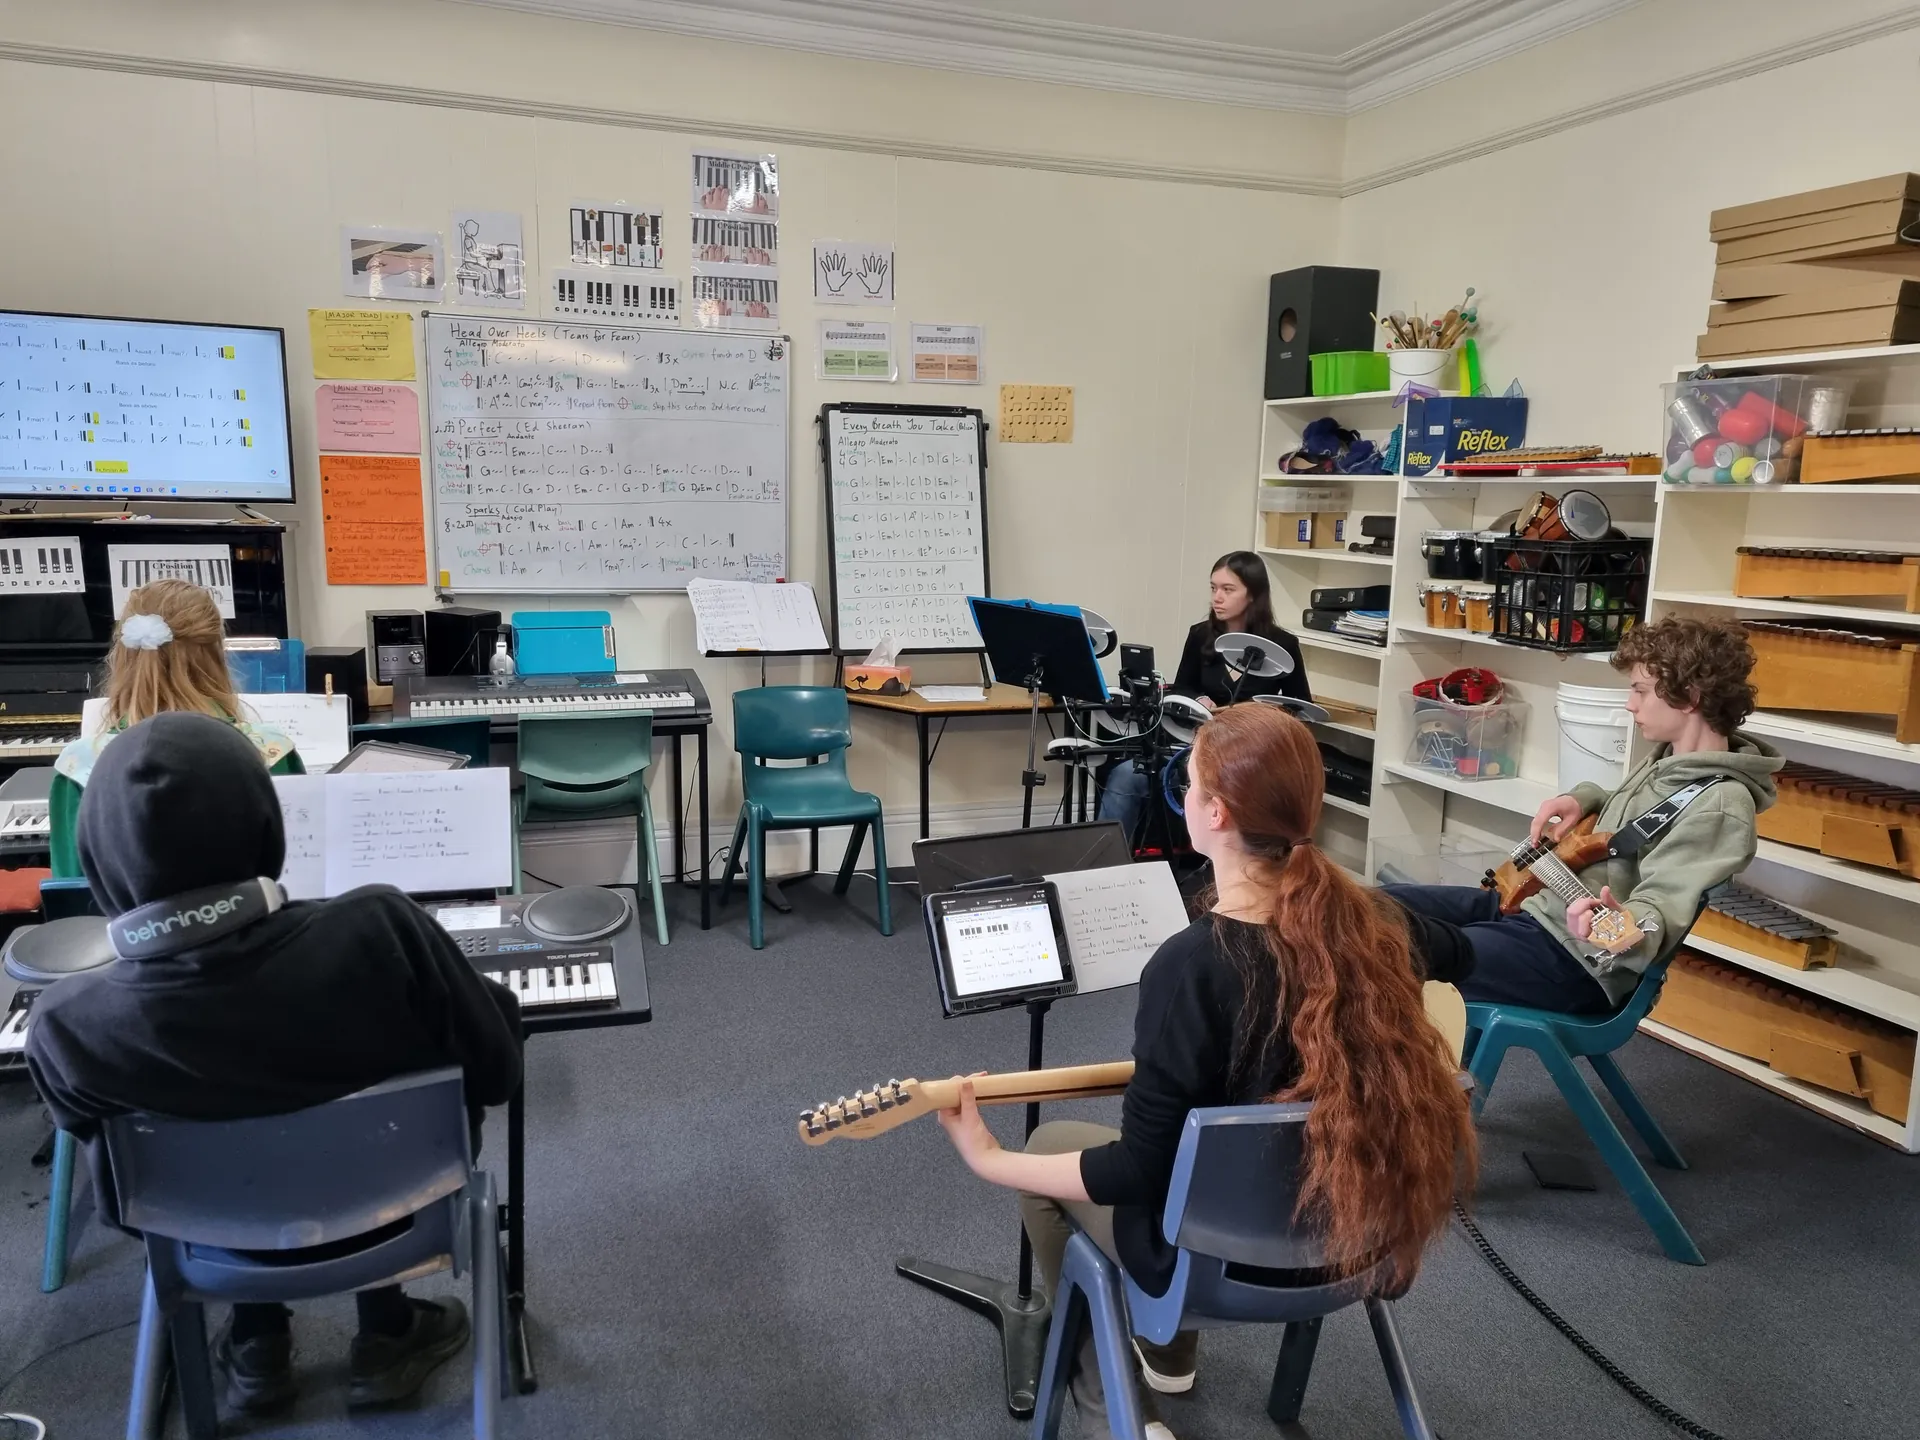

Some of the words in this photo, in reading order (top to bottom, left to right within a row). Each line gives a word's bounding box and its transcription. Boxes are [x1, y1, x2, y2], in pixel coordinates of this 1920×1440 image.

[724, 223, 749, 231] Position
[450, 323, 482, 338] Head
[488, 326, 510, 337] Over
[517, 327, 547, 338] Heels
[594, 328, 606, 342] for
[610, 331, 641, 343] Fears)
[459, 339, 487, 351] Allegro
[456, 350, 474, 358] Intro
[456, 359, 480, 367] Outro
[668, 401, 680, 411] this
[711, 401, 723, 411] 2nd
[725, 401, 740, 411] time
[459, 419, 503, 436] Perfect
[546, 421, 591, 431] Sheeran)
[843, 418, 868, 434] Every
[872, 418, 901, 430] Breath
[907, 418, 923, 431] You
[930, 419, 954, 431] Take
[838, 437, 866, 451] Allegro
[869, 437, 898, 446] Moderato
[1457, 429, 1509, 453] Reflex
[476, 446, 486, 456] G
[330, 458, 369, 466] PRACTICE
[373, 459, 418, 467] STRATEGIES
[849, 456, 858, 465] G
[881, 456, 893, 464] Em
[942, 455, 949, 463] G
[1407, 452, 1432, 466] Reflex
[480, 465, 491, 476] G
[850, 478, 858, 488] G
[879, 478, 891, 486] Em
[938, 478, 949, 486] Em
[439, 485, 466, 495] Chorus
[852, 493, 859, 502] G
[878, 492, 890, 501] Em
[940, 491, 947, 499] G
[466, 504, 500, 515] Sparks
[537, 503, 562, 516] Play)
[880, 513, 887, 521] G
[537, 522, 550, 531] 4x
[621, 519, 634, 529] Am
[658, 517, 672, 527] 4x
[855, 531, 862, 541] G
[882, 532, 893, 540] Em
[939, 529, 950, 537] Em
[536, 541, 550, 553] Am
[588, 540, 602, 550] Am
[464, 564, 491, 575] Chorus
[511, 561, 527, 574] Am
[723, 558, 736, 568] Am
[854, 570, 866, 579] Em
[917, 568, 928, 576] Em
[854, 586, 861, 594] G
[931, 583, 937, 591] G
[855, 617, 862, 626] G
[879, 616, 891, 625] Em
[936, 614, 946, 623] Em
[957, 627, 970, 636] Em
[123, 894, 244, 945] behringer
